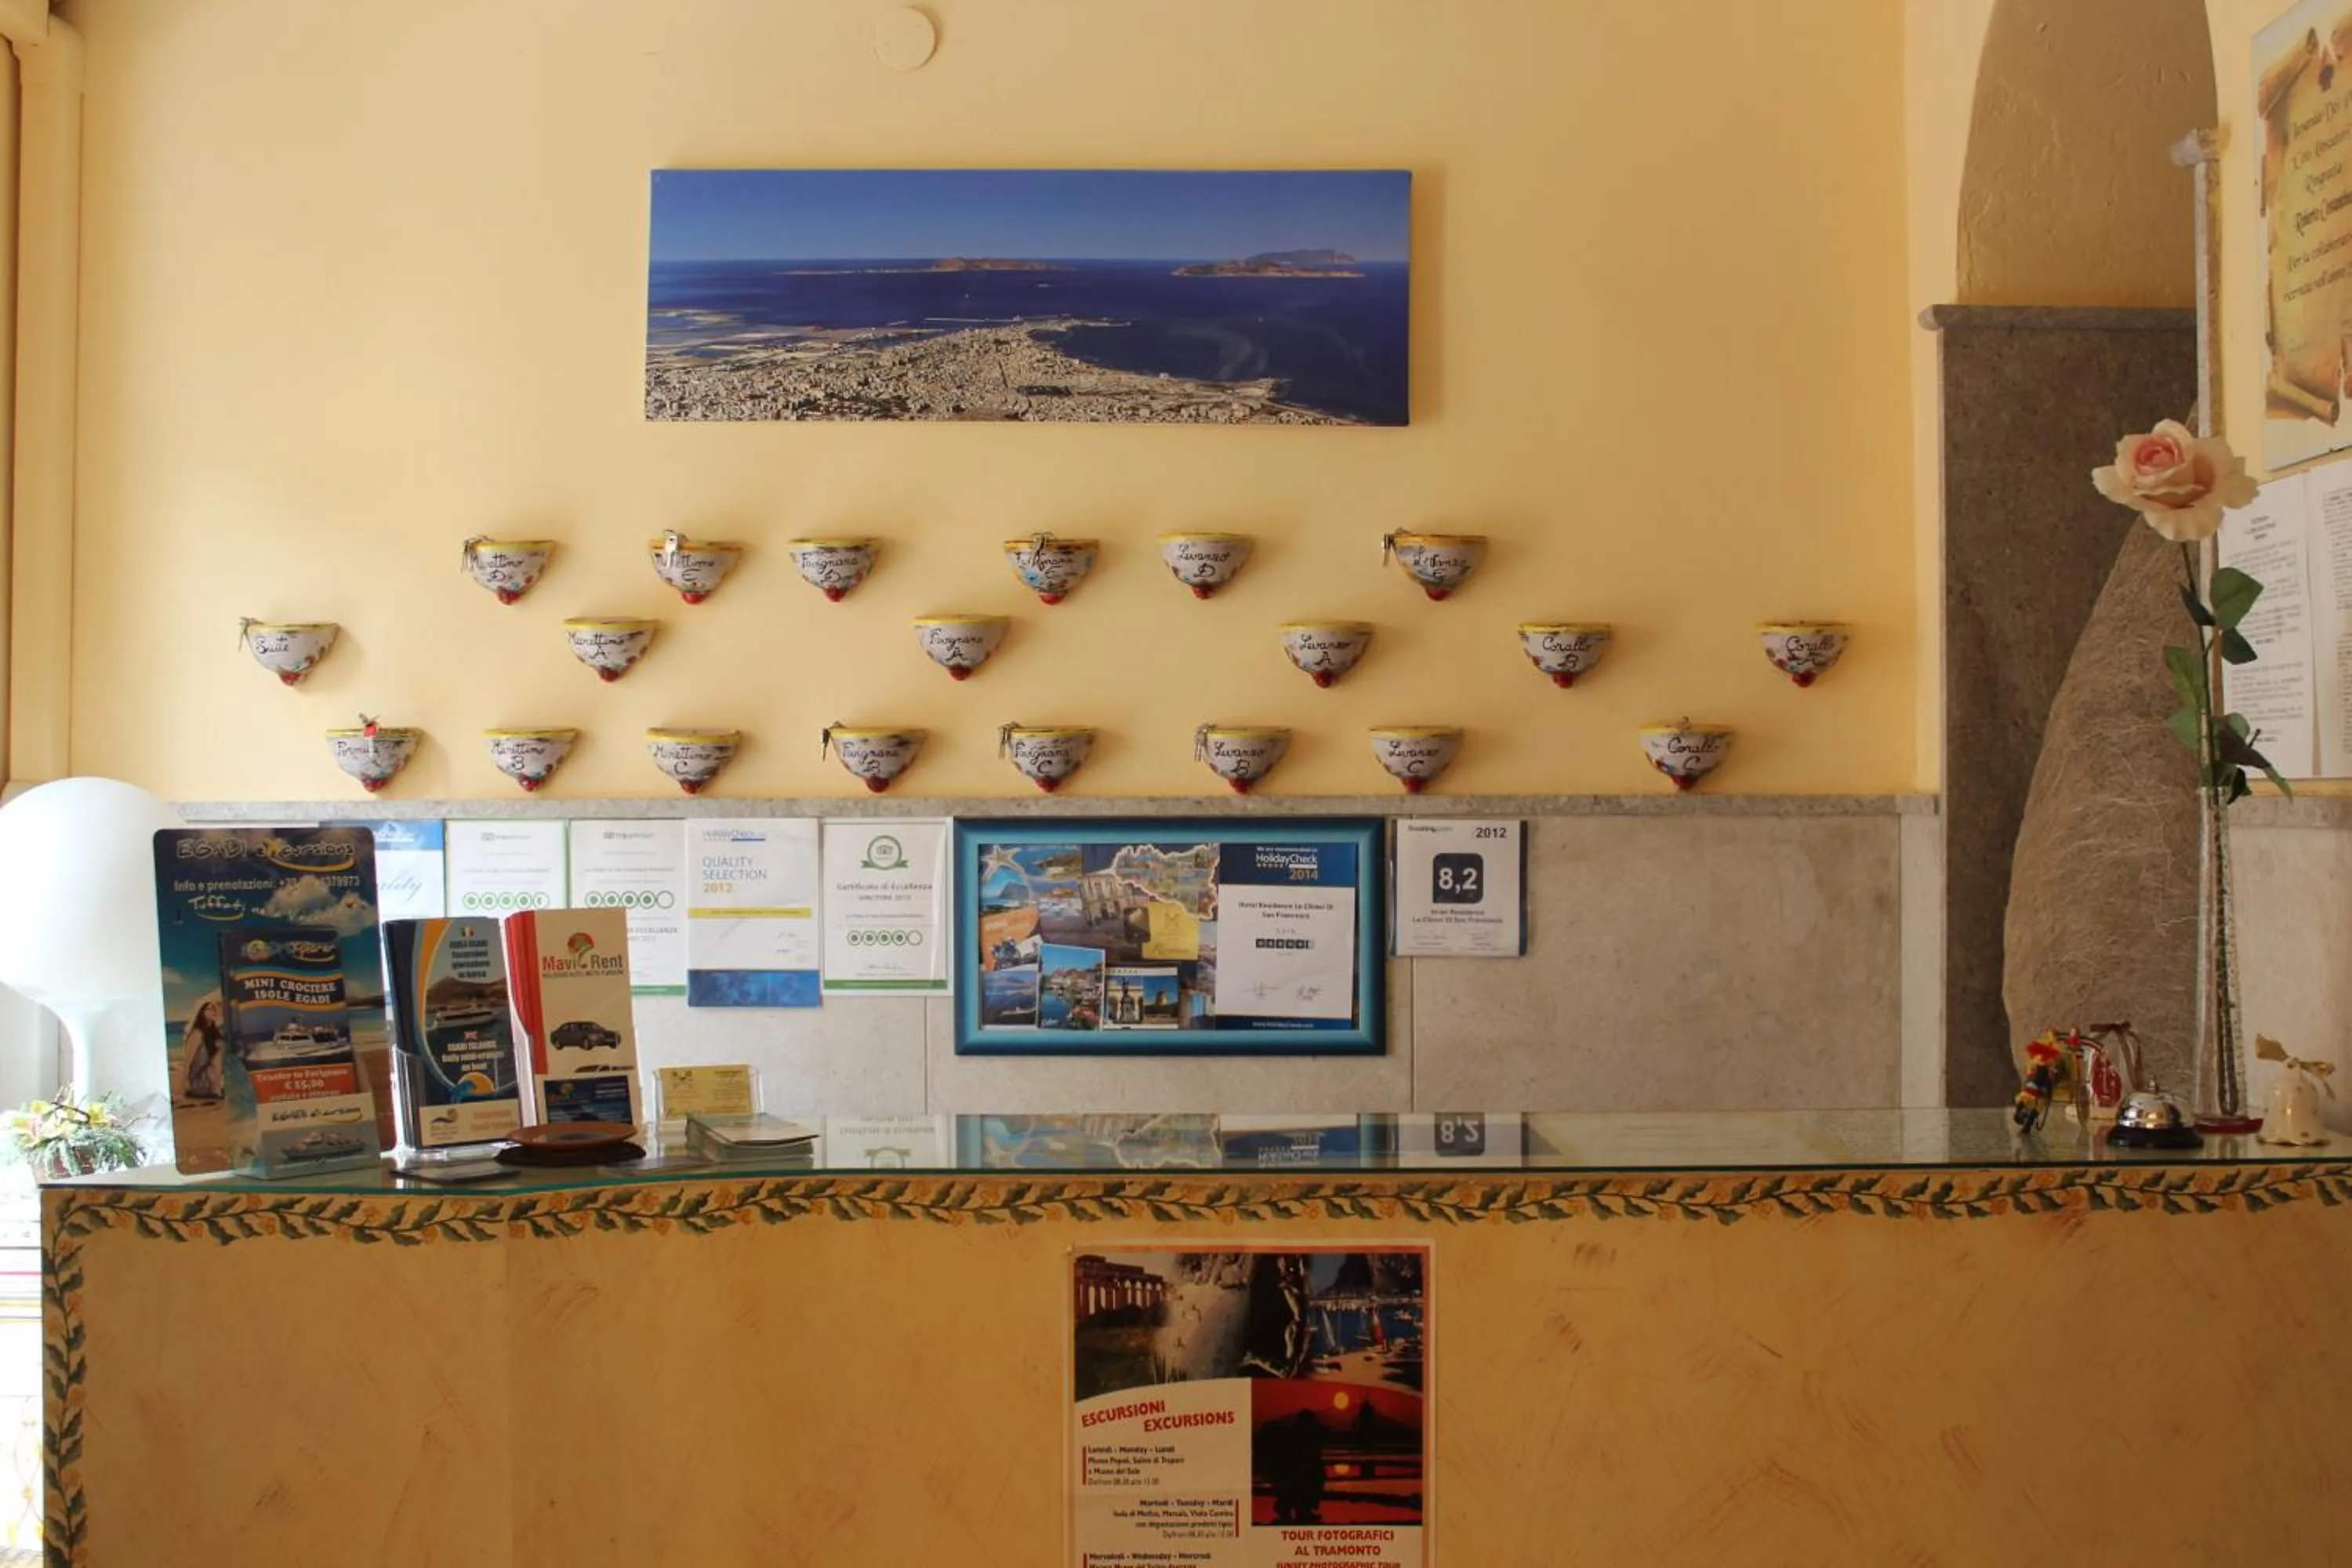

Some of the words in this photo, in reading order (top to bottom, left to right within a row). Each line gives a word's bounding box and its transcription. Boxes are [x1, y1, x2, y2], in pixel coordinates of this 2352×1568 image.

[1542, 636, 1591, 652] Corallo
[1668, 737, 1719, 753] Corallo
[1475, 828, 1507, 838] 2012
[702, 857, 753, 869] QUALITY
[1256, 853, 1318, 865] HolidayCheck
[702, 869, 768, 880] SELECTION
[1290, 869, 1318, 880] 2014
[1438, 867, 1478, 894] 8,2
[174, 879, 195, 891] Info
[702, 883, 735, 893] 2012
[543, 956, 576, 971] Mavi
[590, 953, 623, 969] Rent
[245, 978, 274, 990] MINI
[280, 980, 337, 994] CROCIERE
[254, 990, 291, 1001] ISOLE
[295, 993, 331, 1004] EGADI
[1081, 1400, 1166, 1428] ESCURSIONI
[1144, 1411, 1235, 1432] EXCURSIONS
[1120, 1446, 1148, 1455] Monday
[1161, 1456, 1185, 1465] Trapani
[1177, 1499, 1205, 1508] Tuesday
[1281, 1530, 1315, 1541] TOUR
[1317, 1530, 1395, 1541] FOTOGRAFICI
[1295, 1545, 1310, 1556] AL
[1313, 1545, 1381, 1556] TRAMONTO
